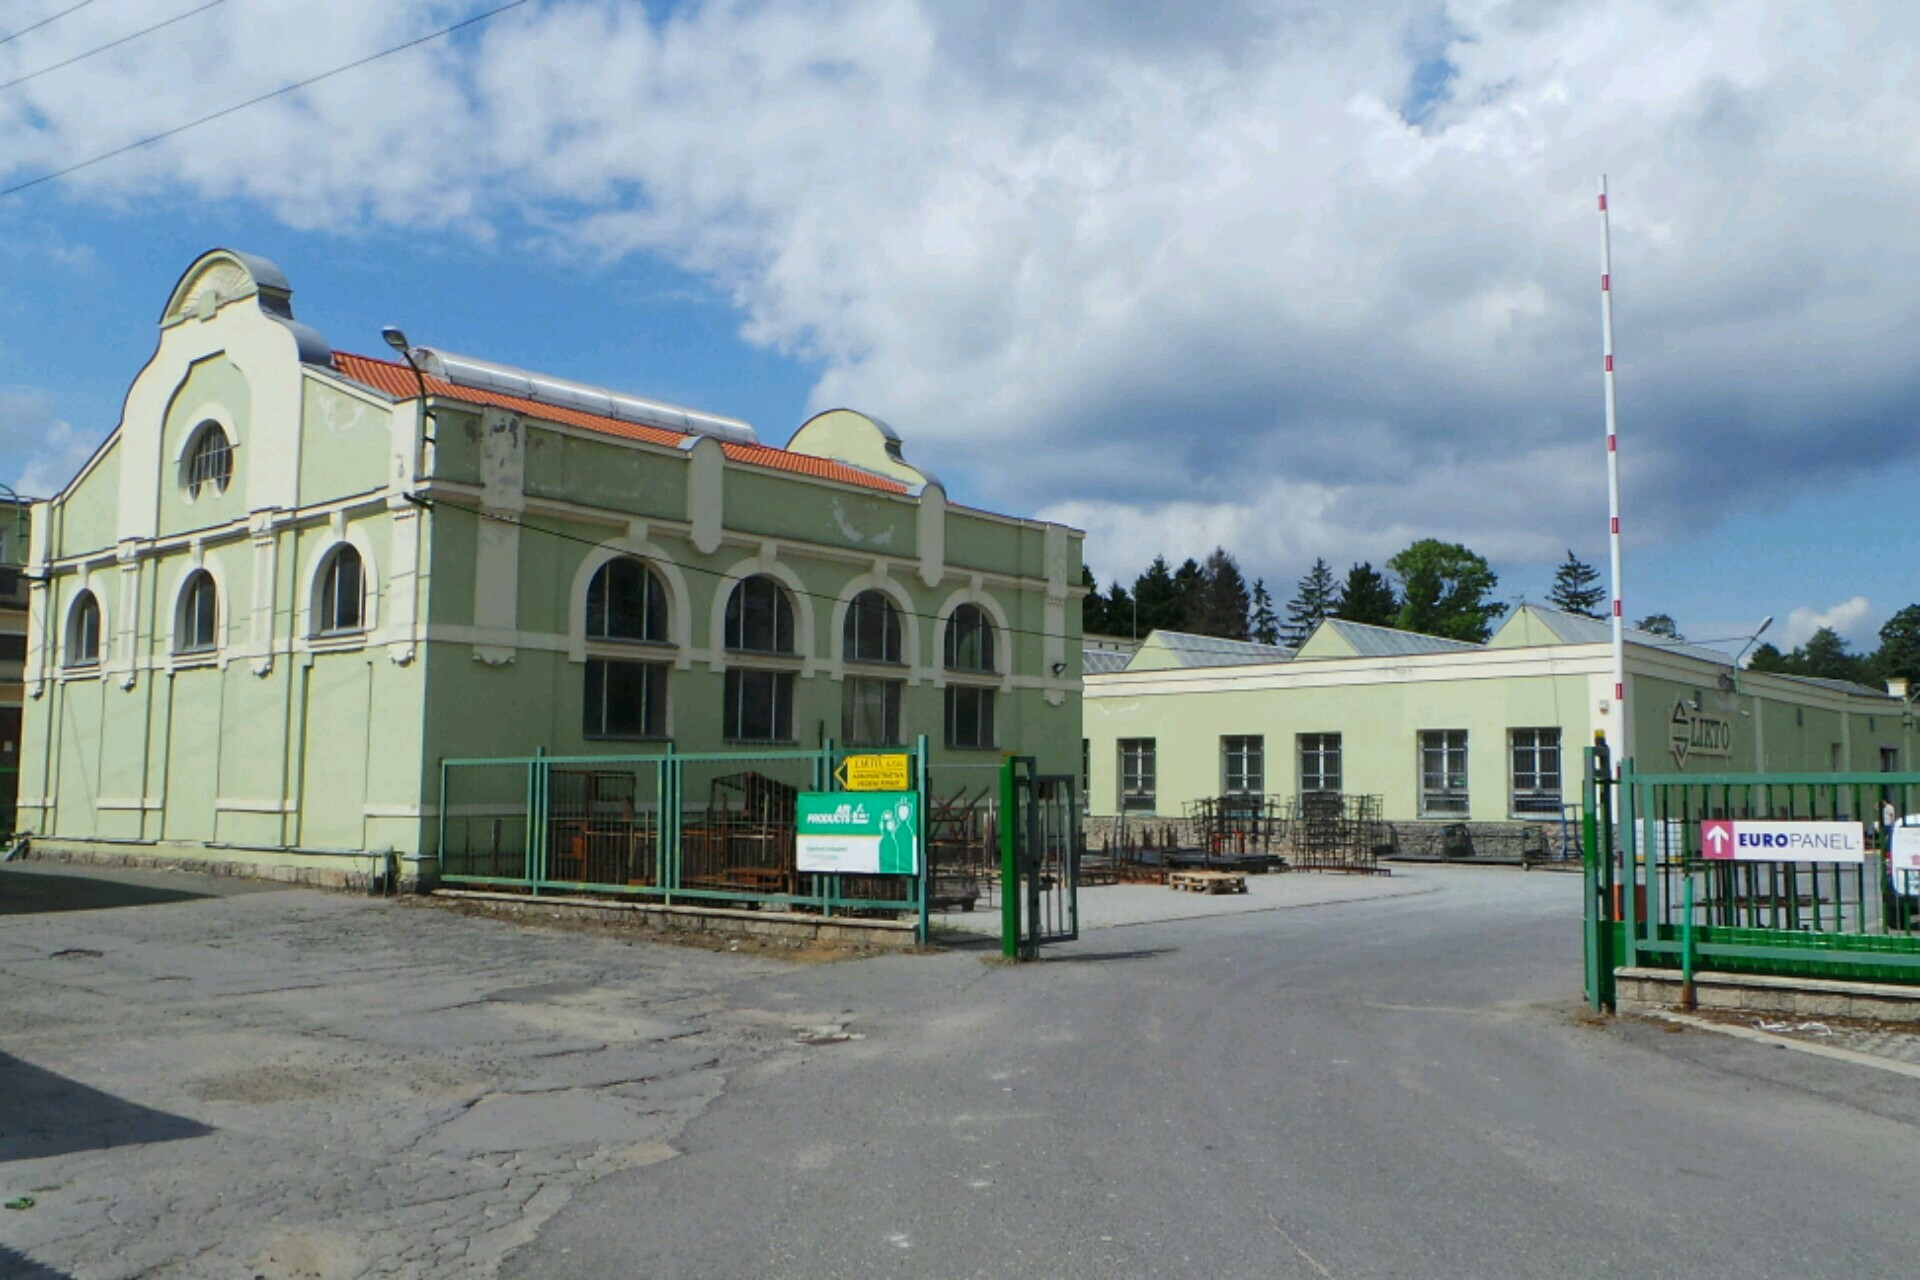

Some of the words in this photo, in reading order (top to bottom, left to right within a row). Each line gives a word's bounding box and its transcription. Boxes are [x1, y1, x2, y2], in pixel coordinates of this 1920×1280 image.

[1691, 717, 1730, 750] LIKTO
[807, 813, 851, 824] PRODUCTS
[1738, 832, 1855, 850] EUROPANEL
